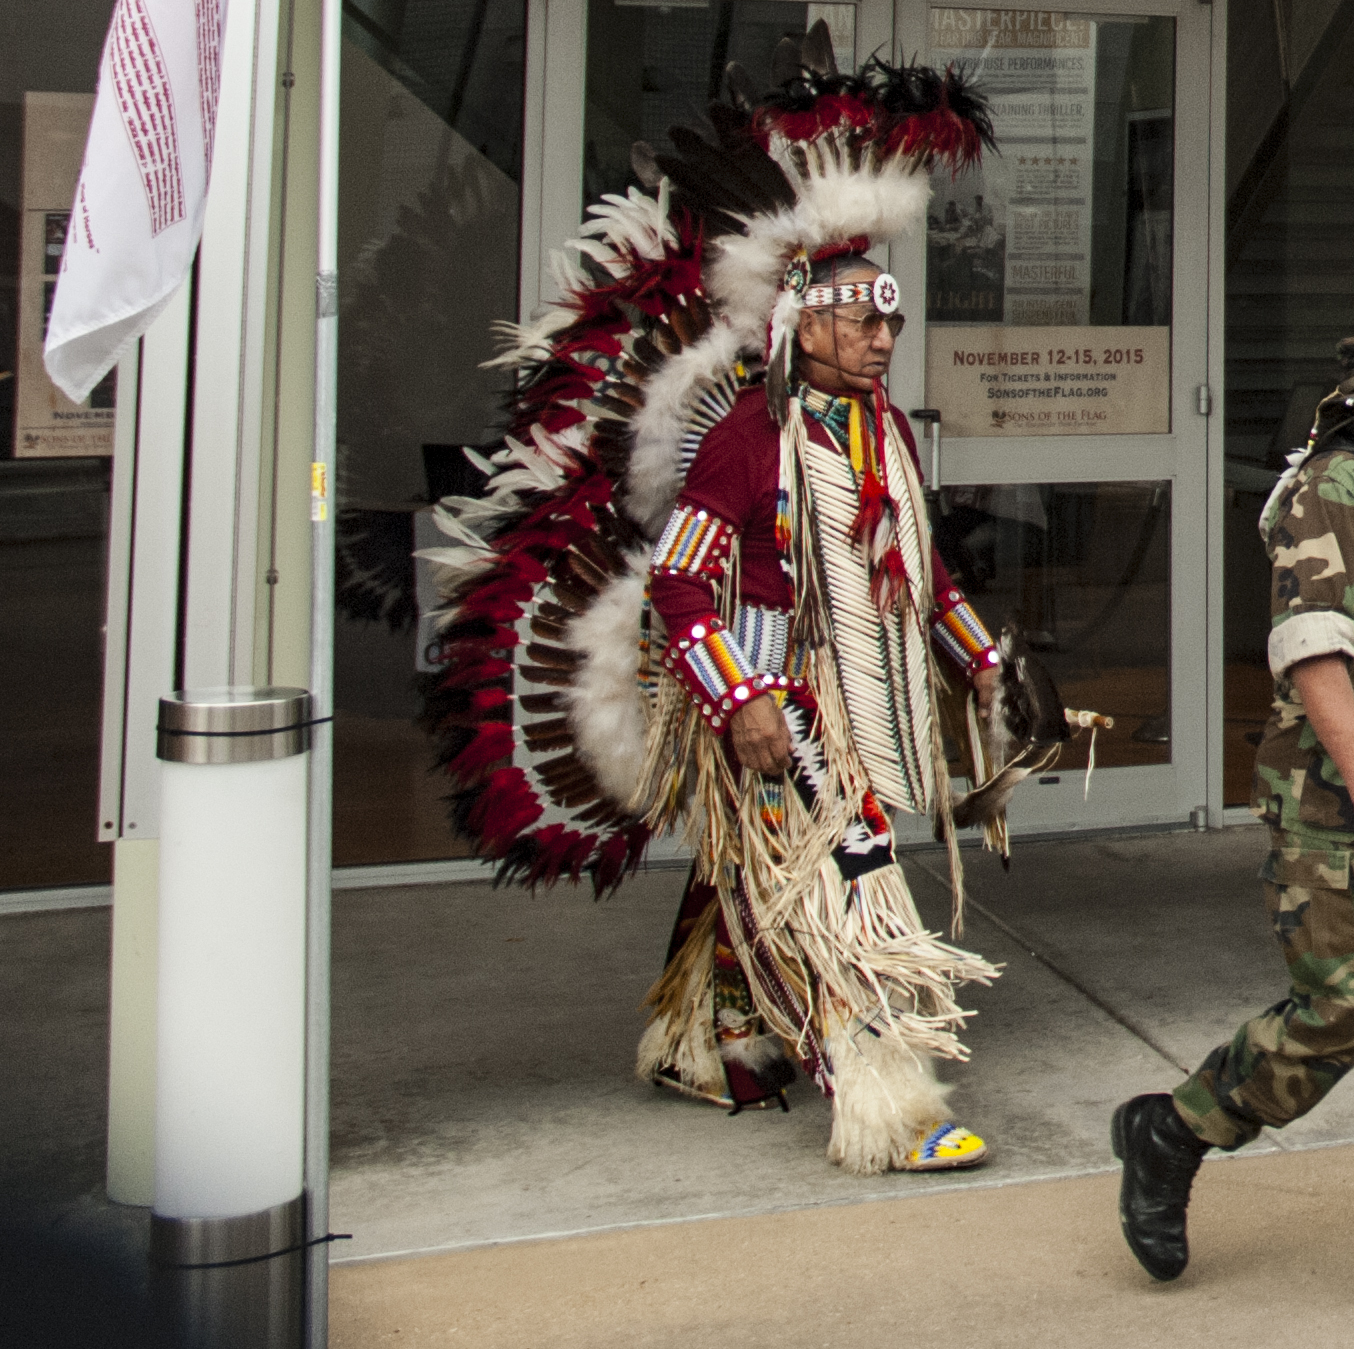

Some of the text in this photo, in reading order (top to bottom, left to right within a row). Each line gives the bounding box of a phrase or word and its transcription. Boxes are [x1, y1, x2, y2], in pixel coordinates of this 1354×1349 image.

[953, 348, 1144, 366] NOVEMBER 12-15, 2015
